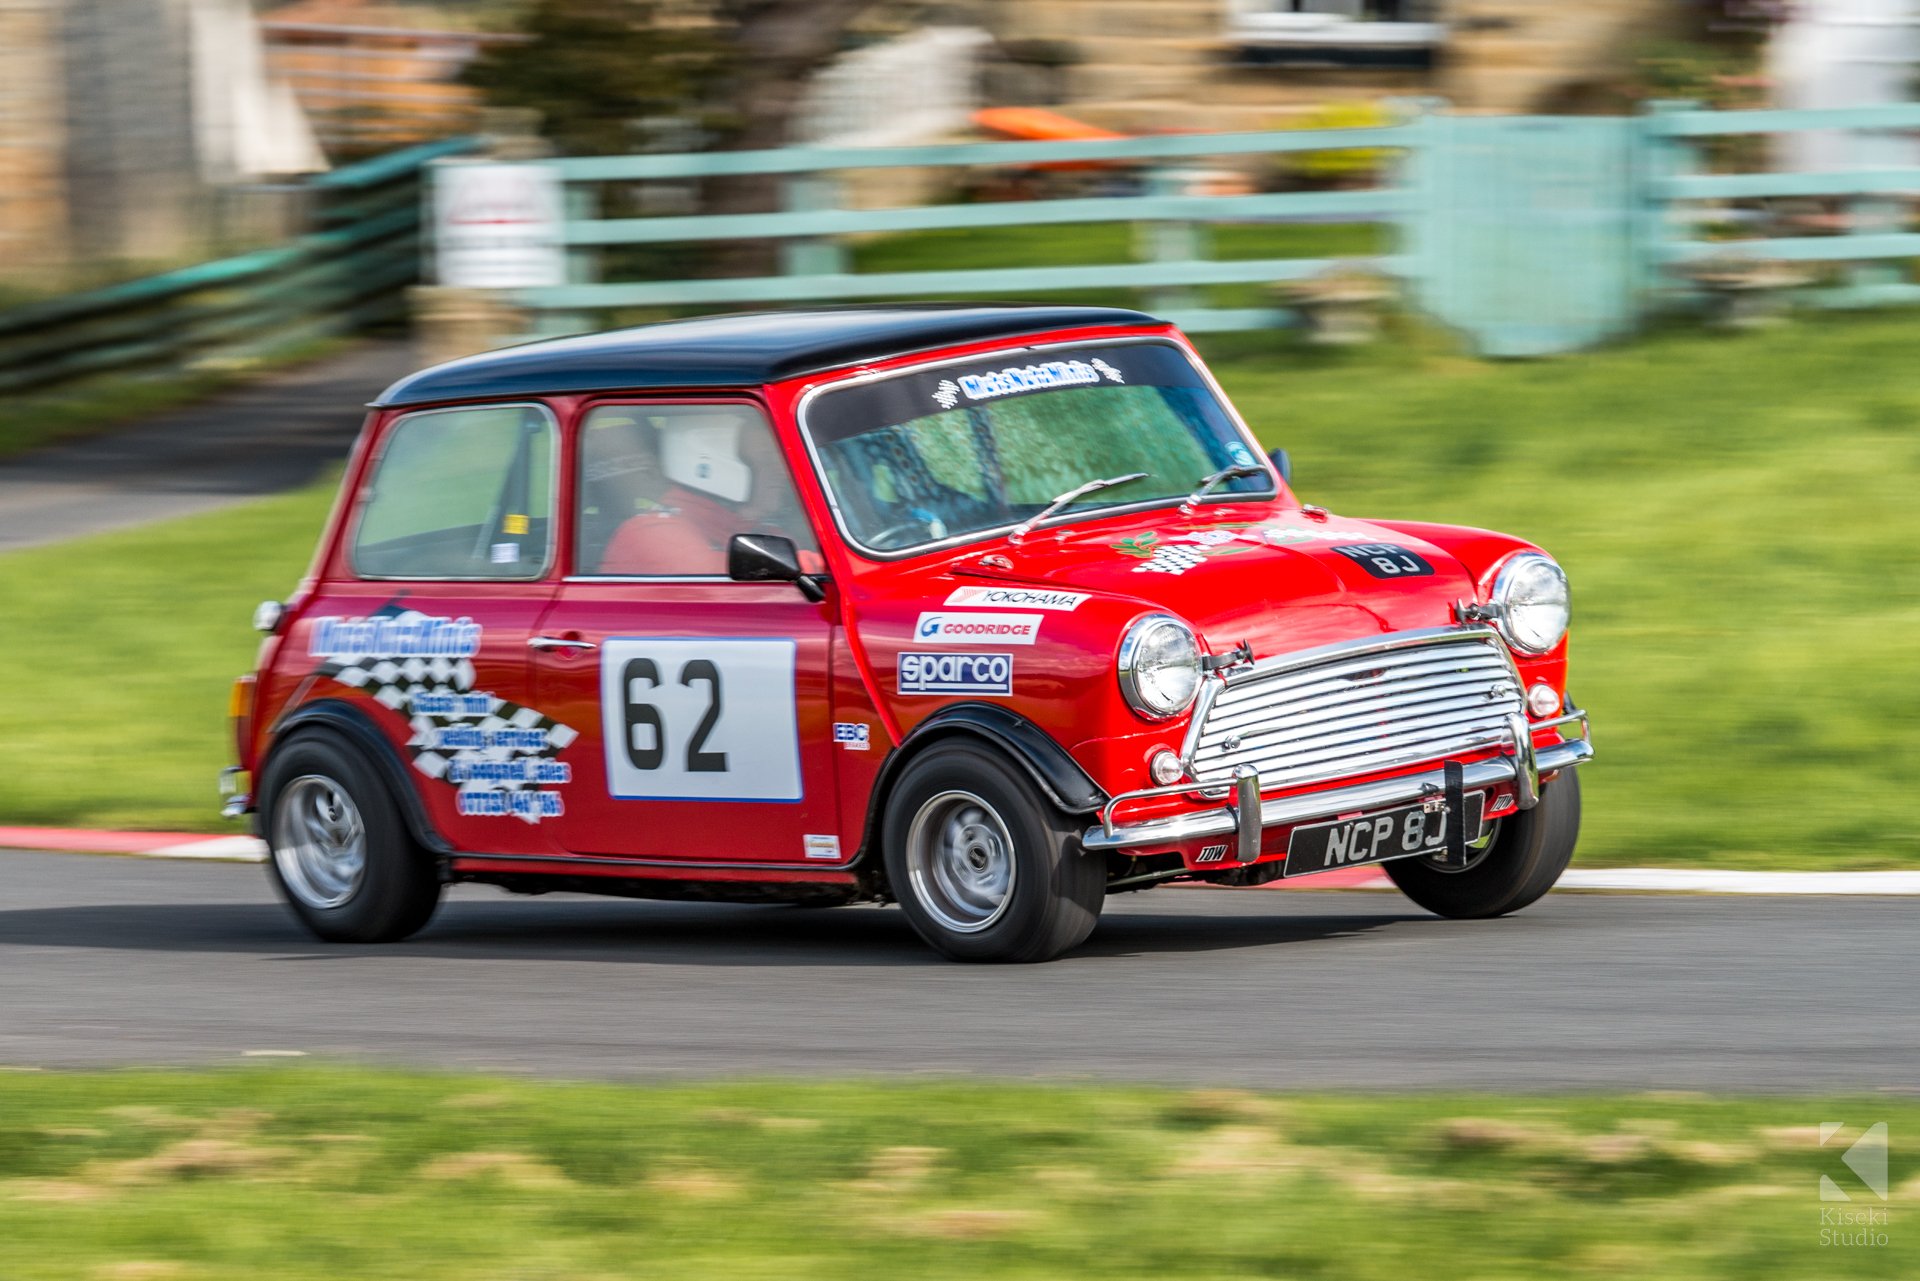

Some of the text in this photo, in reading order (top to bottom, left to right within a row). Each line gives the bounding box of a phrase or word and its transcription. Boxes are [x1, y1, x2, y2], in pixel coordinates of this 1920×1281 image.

[1335, 544, 1399, 558] NCP
[1371, 557, 1421, 574] 8J
[982, 590, 1078, 607] YOKOHAMA
[943, 624, 1032, 636] GOODRIDGE
[902, 655, 1009, 690] sparco
[620, 657, 730, 773] 62
[836, 723, 868, 741] EBC
[1323, 810, 1448, 866] NCP 8J
